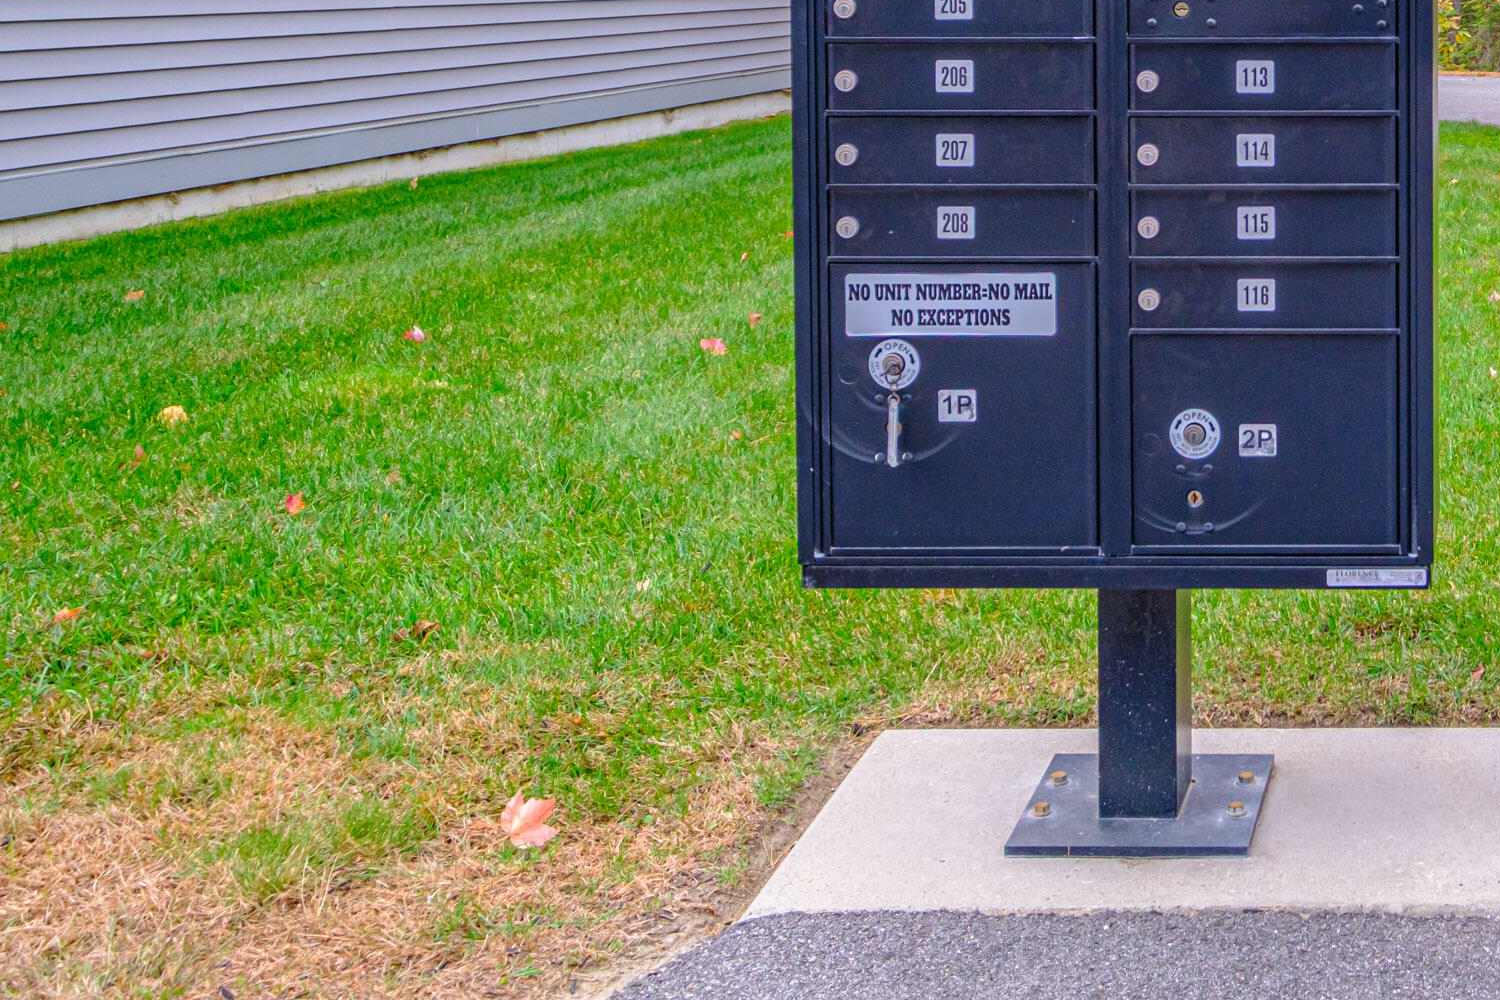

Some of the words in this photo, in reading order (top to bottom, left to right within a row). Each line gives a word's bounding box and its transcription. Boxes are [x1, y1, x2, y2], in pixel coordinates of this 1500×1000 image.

[941, 66, 967, 87] 206
[1241, 66, 1268, 88] 113
[941, 140, 968, 161] 207
[1242, 141, 1269, 161] 114
[942, 212, 969, 234] 208
[1241, 213, 1269, 234] 115
[848, 283, 870, 301] NO
[874, 283, 912, 301] UNIT
[1013, 282, 1053, 300] MAIL
[1242, 285, 1269, 306] 116
[891, 309, 914, 327] NO
[917, 308, 1011, 327] EXCEPTIONS
[884, 342, 910, 354] OPEN
[941, 394, 971, 415] 1P
[1182, 411, 1209, 423] OPEN
[1242, 429, 1273, 449] 2P
